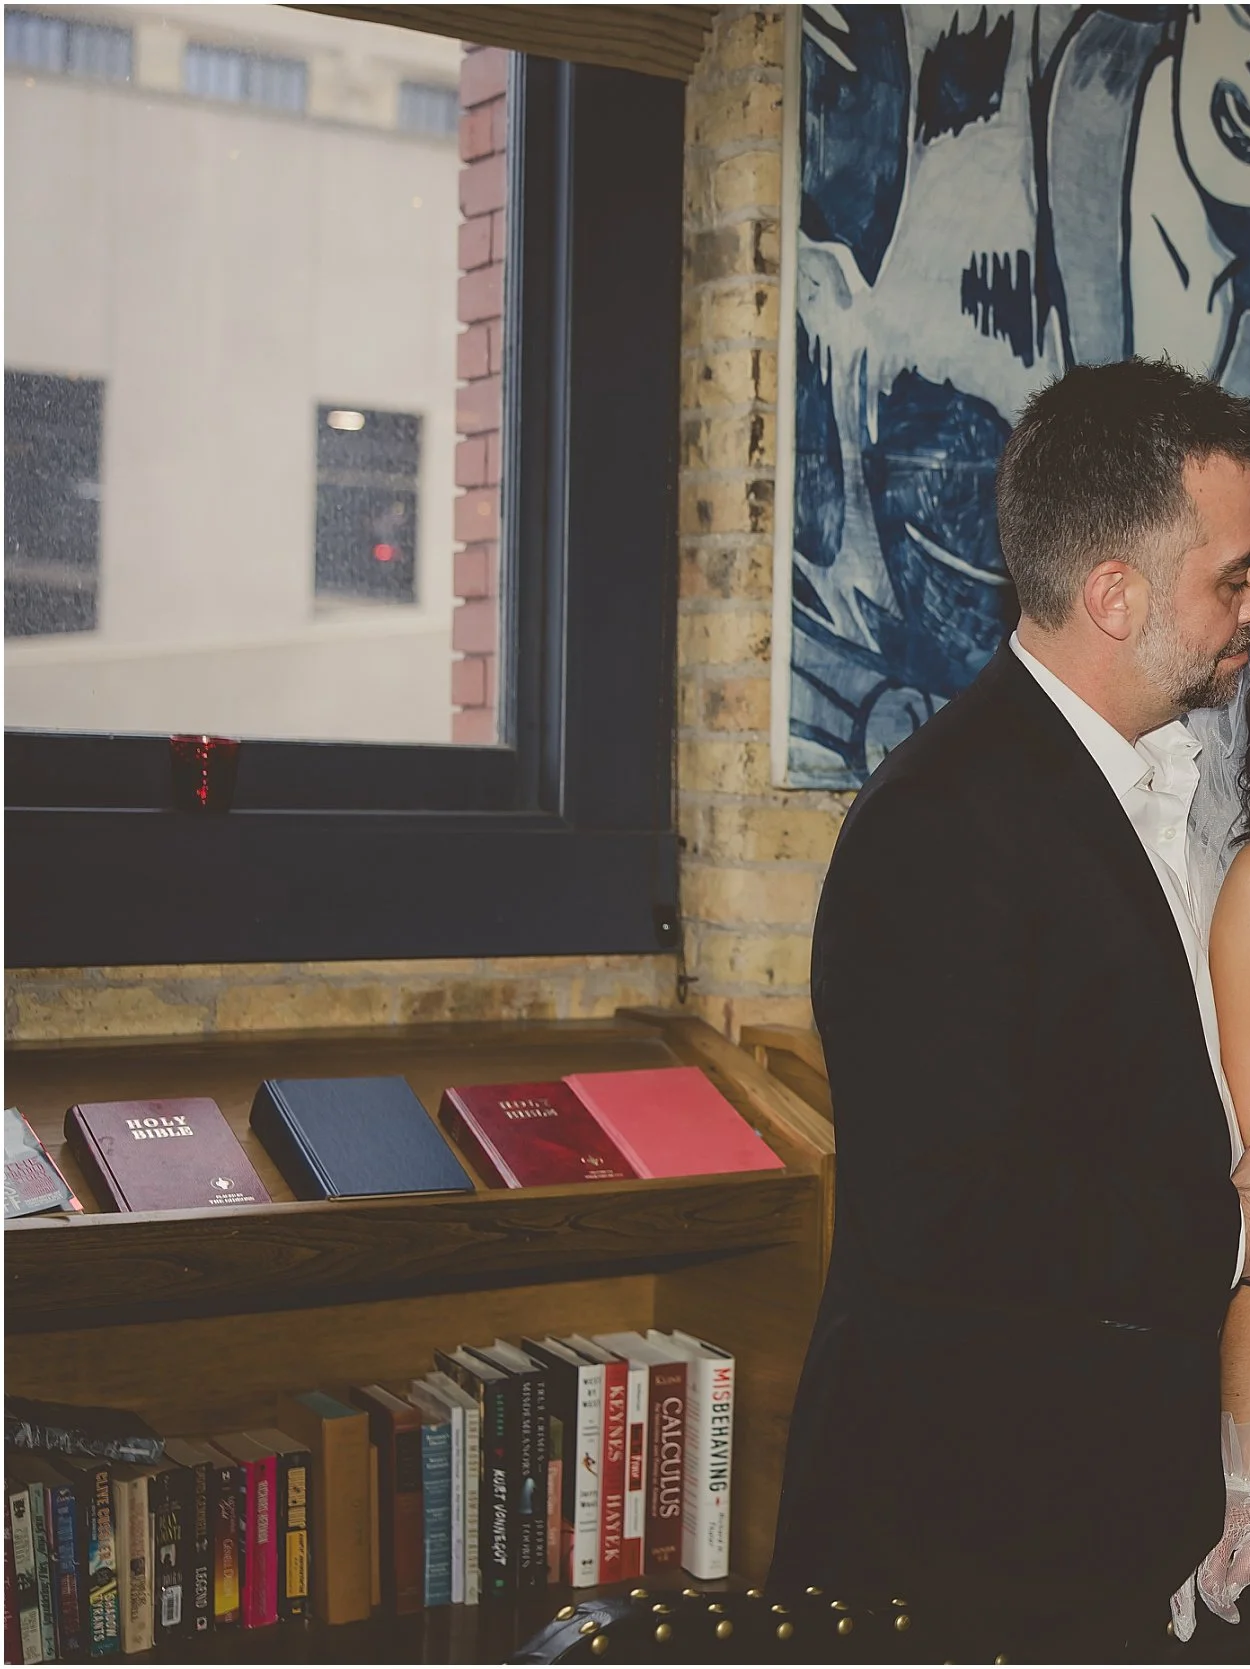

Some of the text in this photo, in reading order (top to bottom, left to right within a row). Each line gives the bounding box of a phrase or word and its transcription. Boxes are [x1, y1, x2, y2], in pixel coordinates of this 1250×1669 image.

[126, 1115, 187, 1130] HOLY
[131, 1126, 194, 1140] BIBLE
[659, 1396, 684, 1520] CALCULUS
[708, 1367, 732, 1493] MISBEHAVING
[96, 1471, 110, 1506] CLIVE
[604, 1385, 625, 1562] KEYNES HAYEK
[493, 1468, 508, 1567] KURT VONNEGUT
[93, 1592, 105, 1643] TYRANTS
